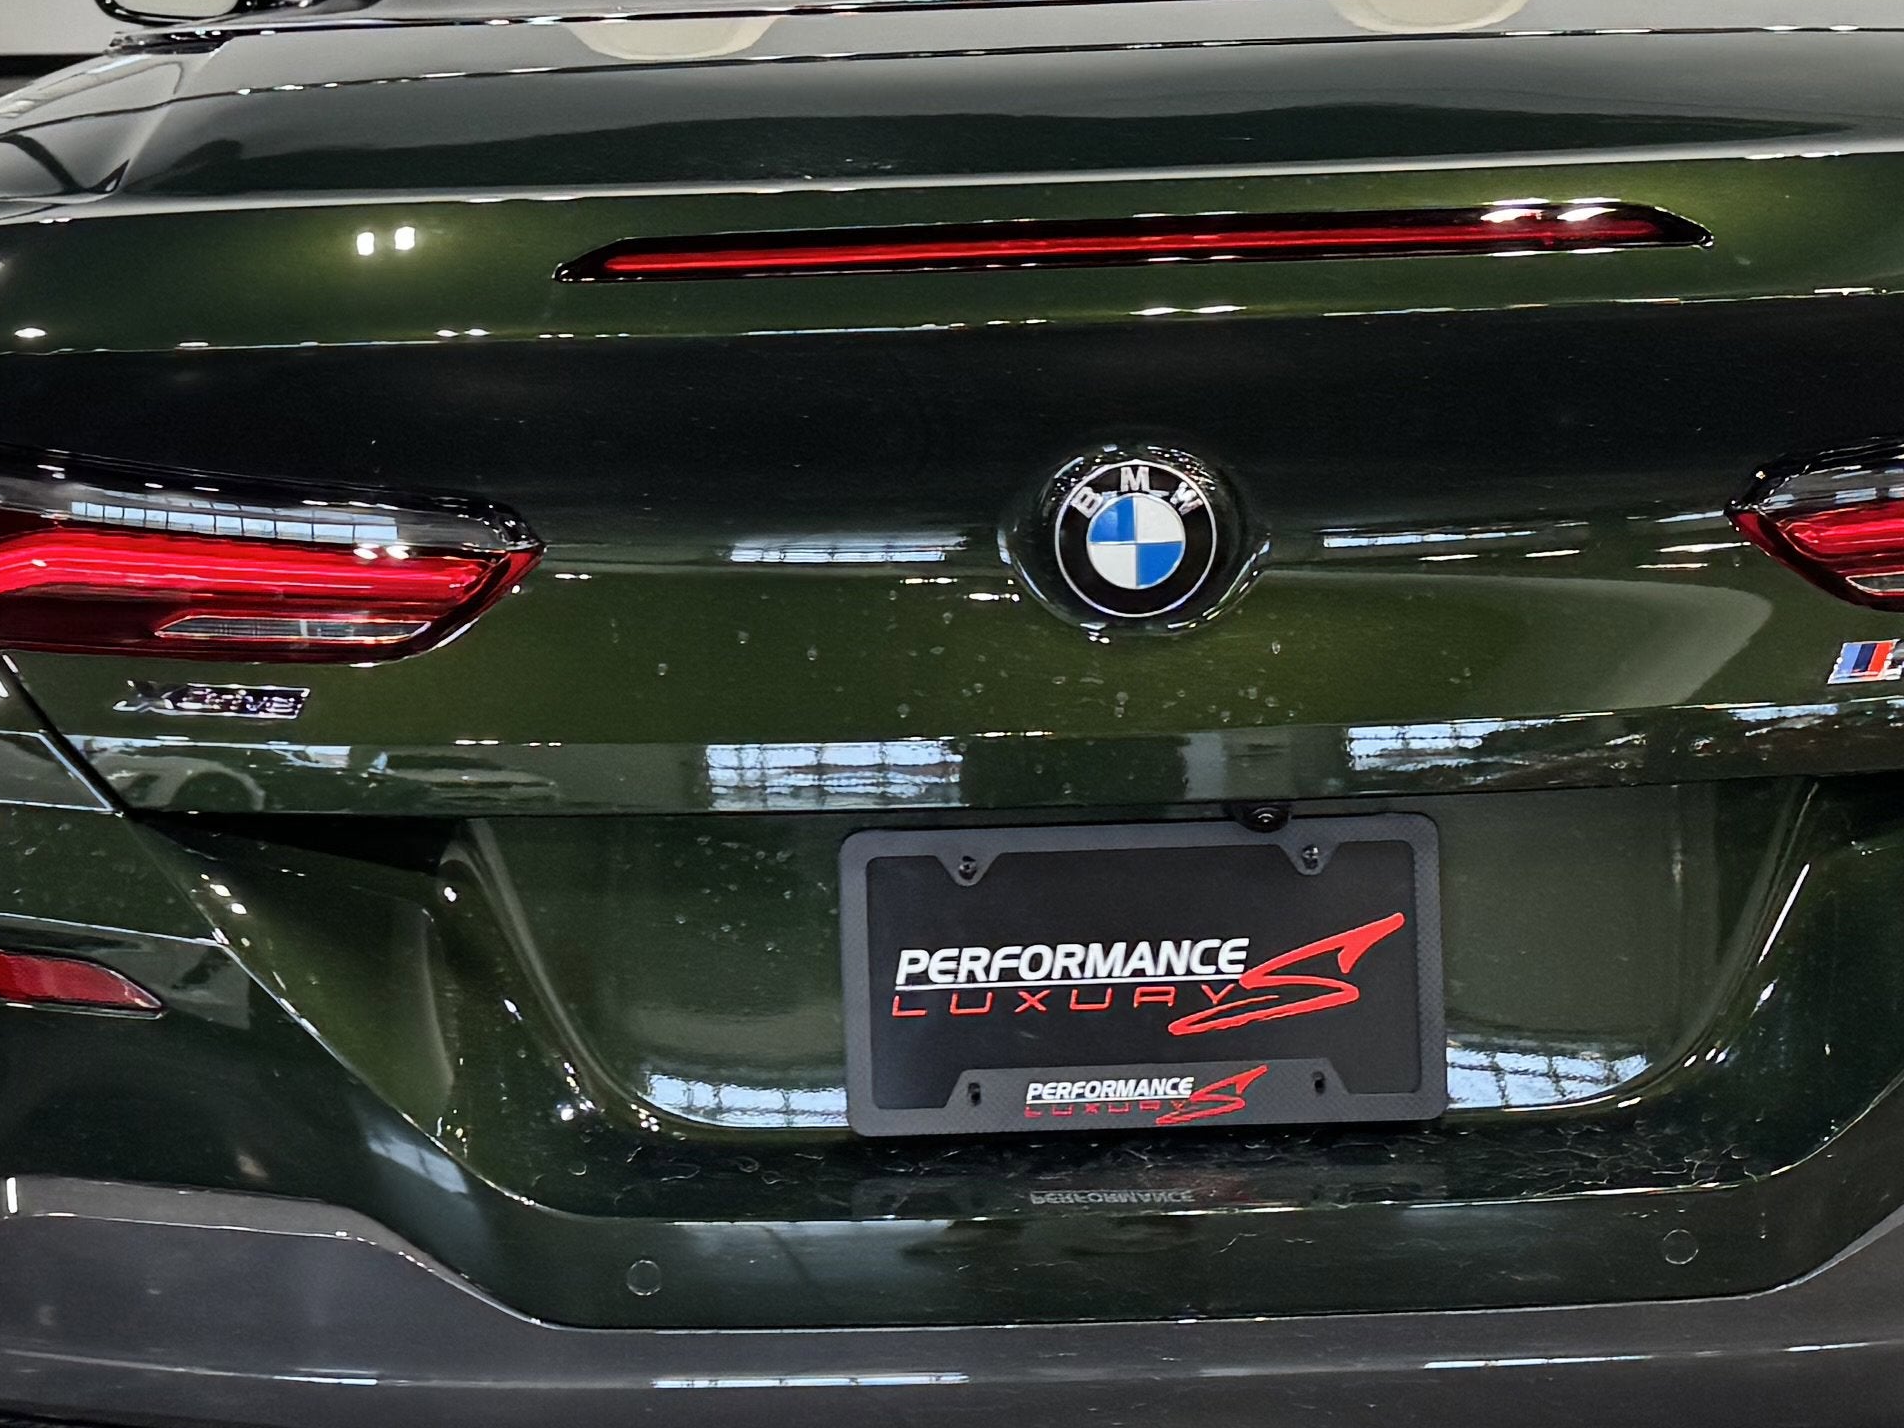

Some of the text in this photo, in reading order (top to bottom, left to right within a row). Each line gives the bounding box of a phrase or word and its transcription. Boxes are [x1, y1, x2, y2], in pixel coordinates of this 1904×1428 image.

[1070, 466, 1204, 519] BMW
[896, 937, 1251, 985] PERFORMANCE
[891, 983, 1243, 1018] LUXURY
[1025, 1076, 1195, 1101] PERFORMANCE
